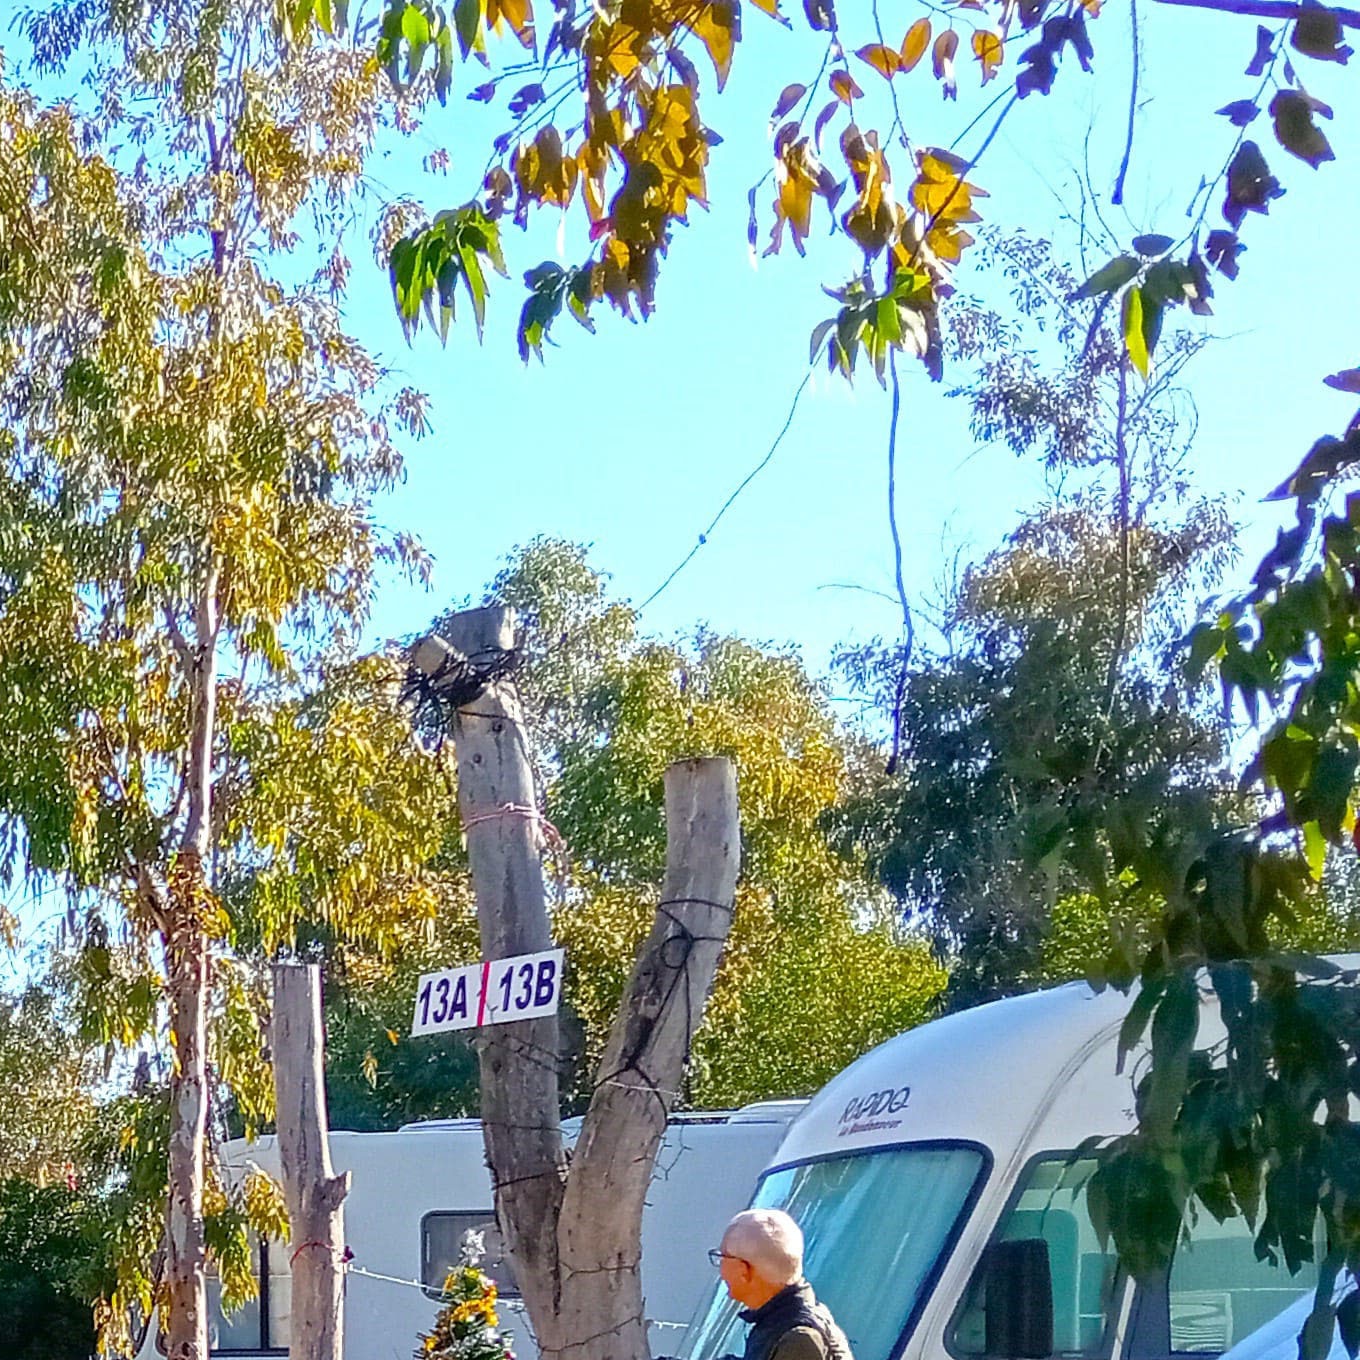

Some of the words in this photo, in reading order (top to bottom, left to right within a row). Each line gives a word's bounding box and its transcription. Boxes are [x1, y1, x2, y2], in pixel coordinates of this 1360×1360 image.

[419, 974, 467, 1026] 13A
[499, 959, 556, 1013] 13B
[838, 1086, 911, 1125] RAPIDO
